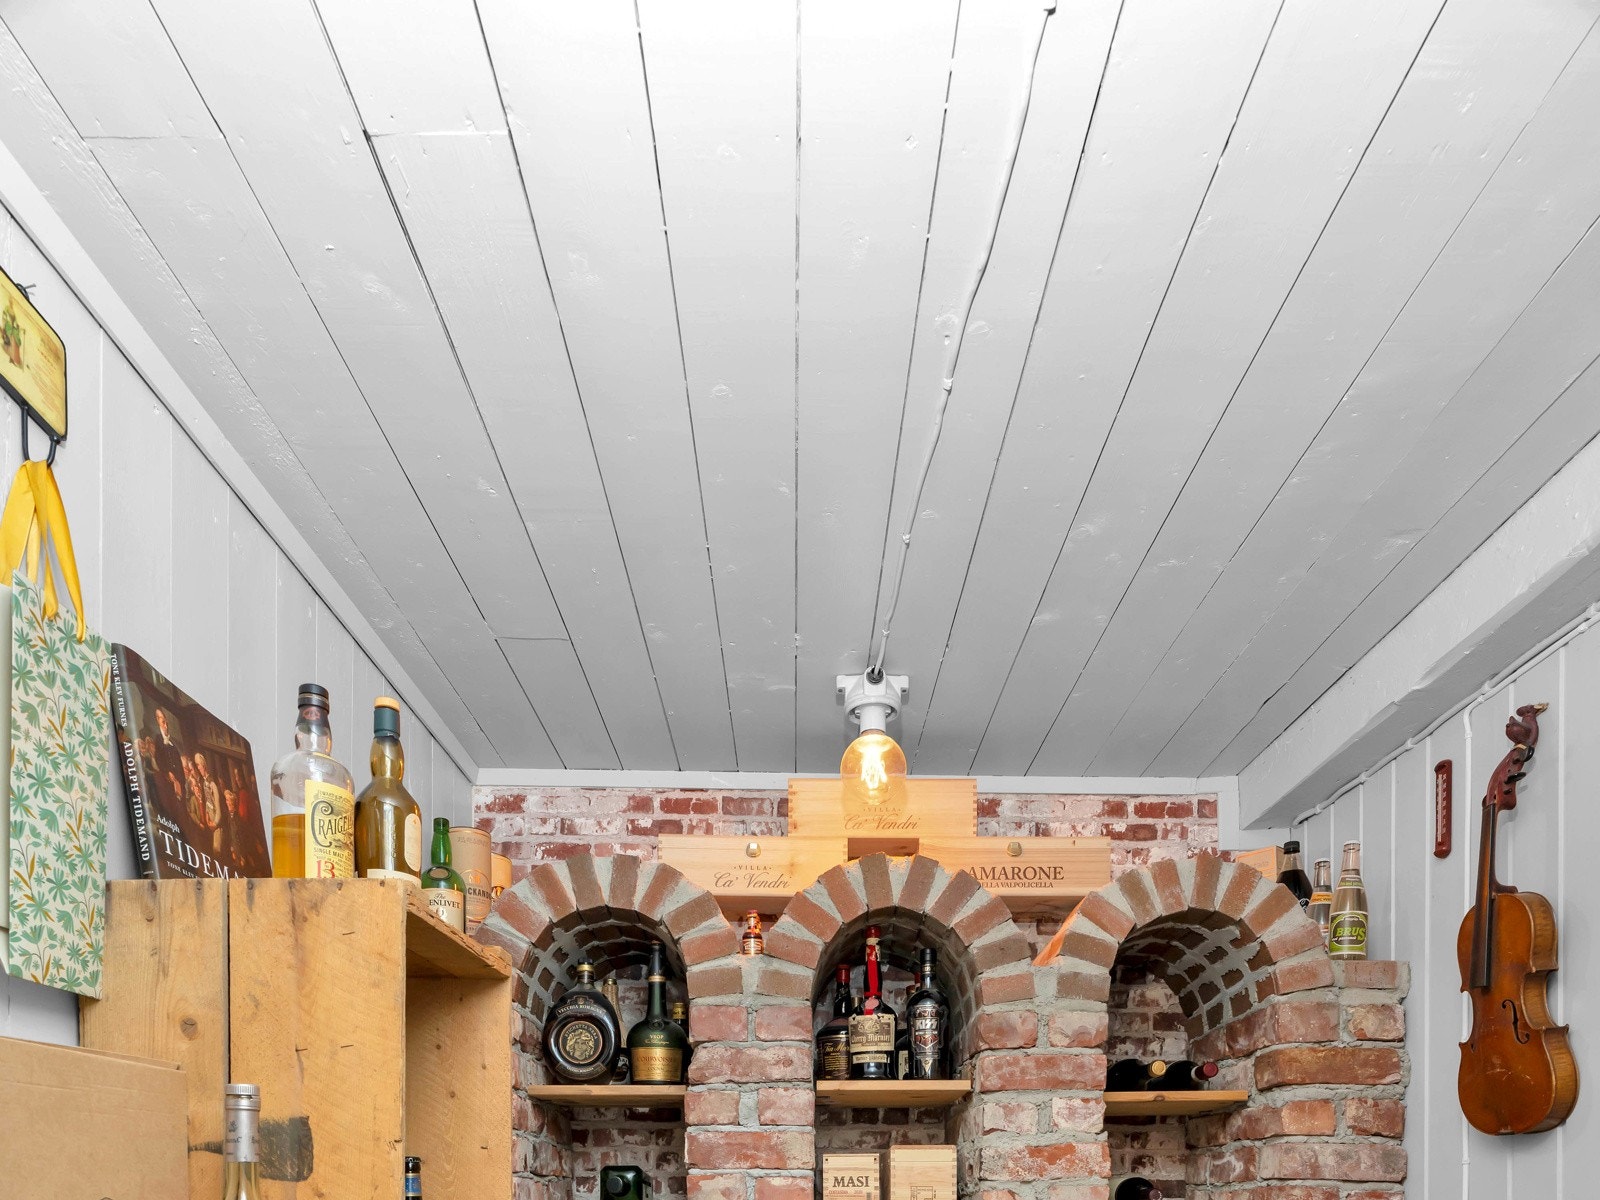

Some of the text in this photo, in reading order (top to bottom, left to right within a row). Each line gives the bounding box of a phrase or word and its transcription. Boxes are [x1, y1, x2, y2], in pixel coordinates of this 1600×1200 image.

[123, 741, 138, 792] ADOLPH
[132, 795, 150, 861] TIDEMAND
[156, 814, 181, 833] Adolph
[743, 871, 792, 888] Vendri
[968, 866, 1065, 880] AMARONE
[1336, 926, 1367, 941] BRUS
[832, 1176, 870, 1188] MASI
